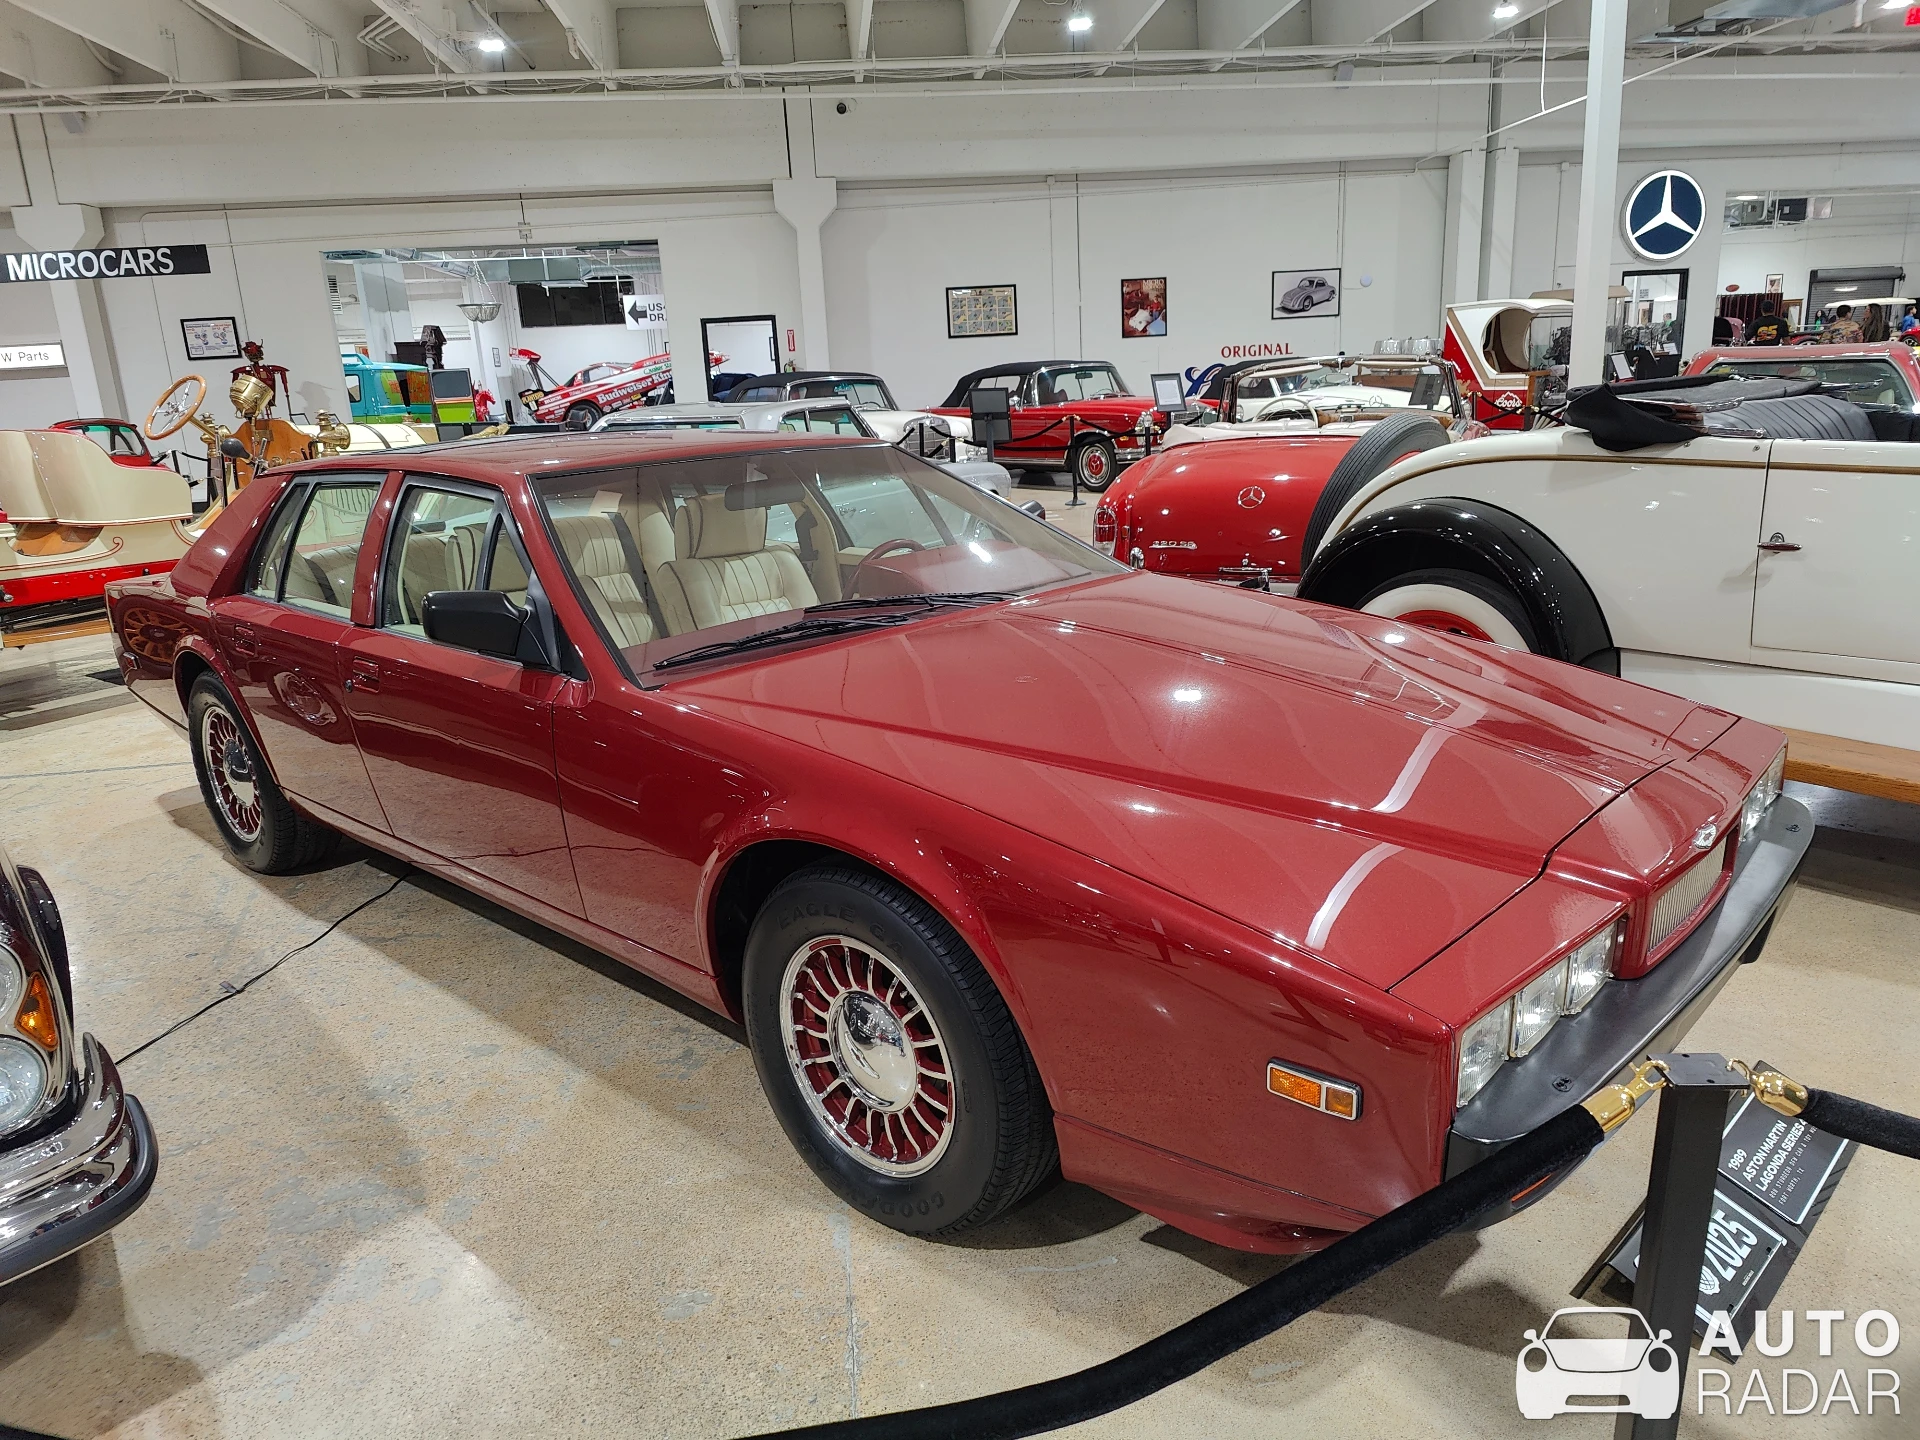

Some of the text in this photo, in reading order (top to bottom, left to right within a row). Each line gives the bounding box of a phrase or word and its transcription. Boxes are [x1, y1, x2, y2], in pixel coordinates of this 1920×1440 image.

[6, 247, 175, 281] MICROCARS
[18, 351, 50, 362] Parts
[1221, 343, 1293, 359] ORIGINAL
[596, 377, 652, 405] Budweiser
[1497, 397, 1522, 408] Coors
[776, 901, 856, 930] EAGLE
[1728, 1148, 1748, 1171] 1989
[1742, 1119, 1788, 1182] ASTON MARTIN
[1755, 1149, 1789, 1192] LAGONDA
[1781, 1121, 1805, 1152] SERIES
[1704, 1208, 1758, 1282] 2025
